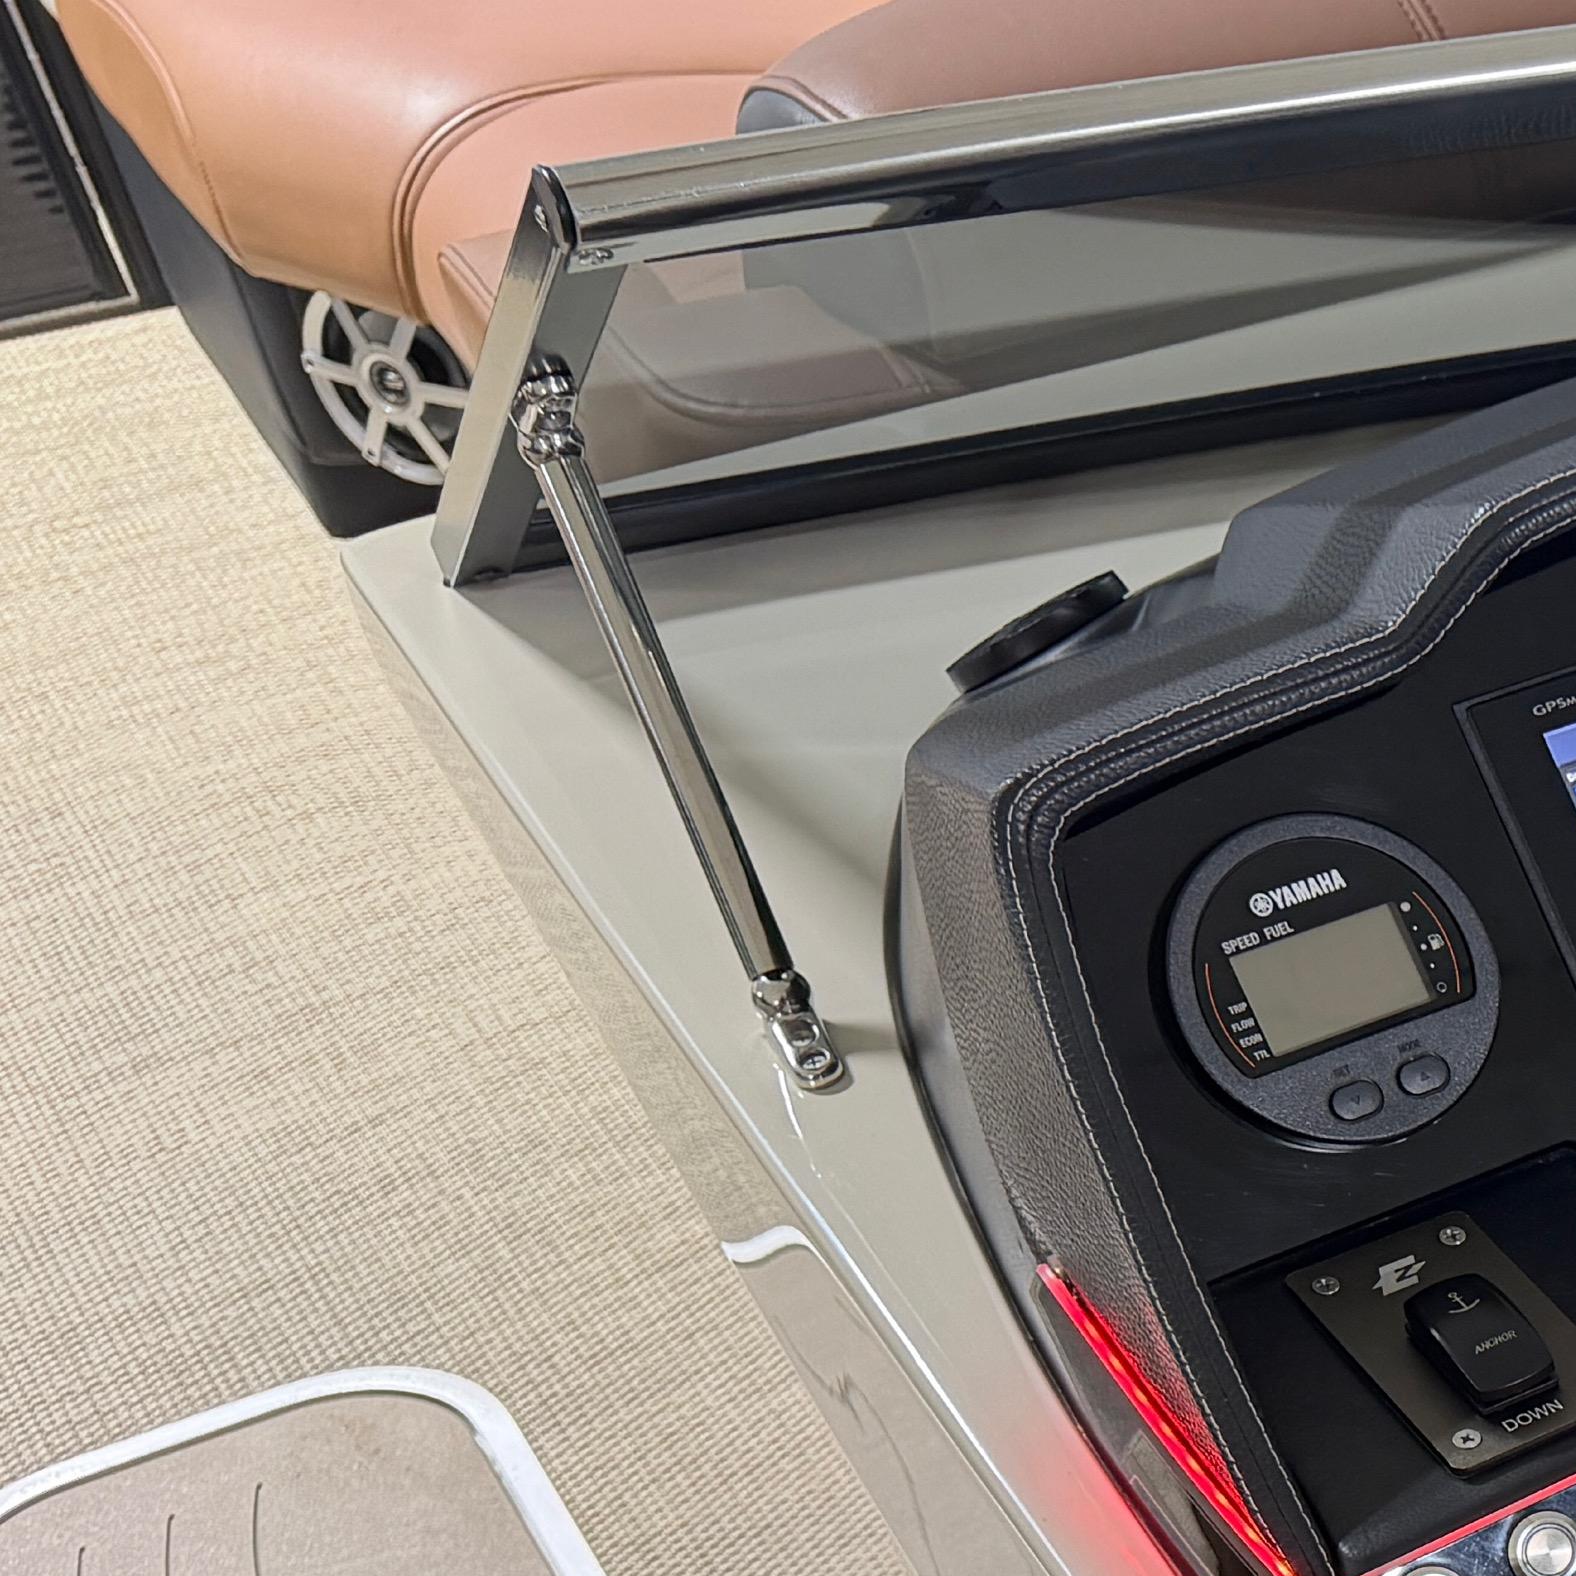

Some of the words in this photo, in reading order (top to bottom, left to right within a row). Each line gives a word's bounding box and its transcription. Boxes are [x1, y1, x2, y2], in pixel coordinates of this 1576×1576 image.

[1268, 868, 1347, 911] YAMAHA
[1221, 932, 1260, 956] SPEED
[1264, 920, 1294, 943] FUEL
[1228, 1001, 1248, 1016] TRIP
[1231, 1018, 1255, 1033] FLOW
[1239, 1033, 1263, 1048] ECON
[1474, 1328, 1518, 1355] ANCHOR
[1500, 1399, 1565, 1434] DOWN
